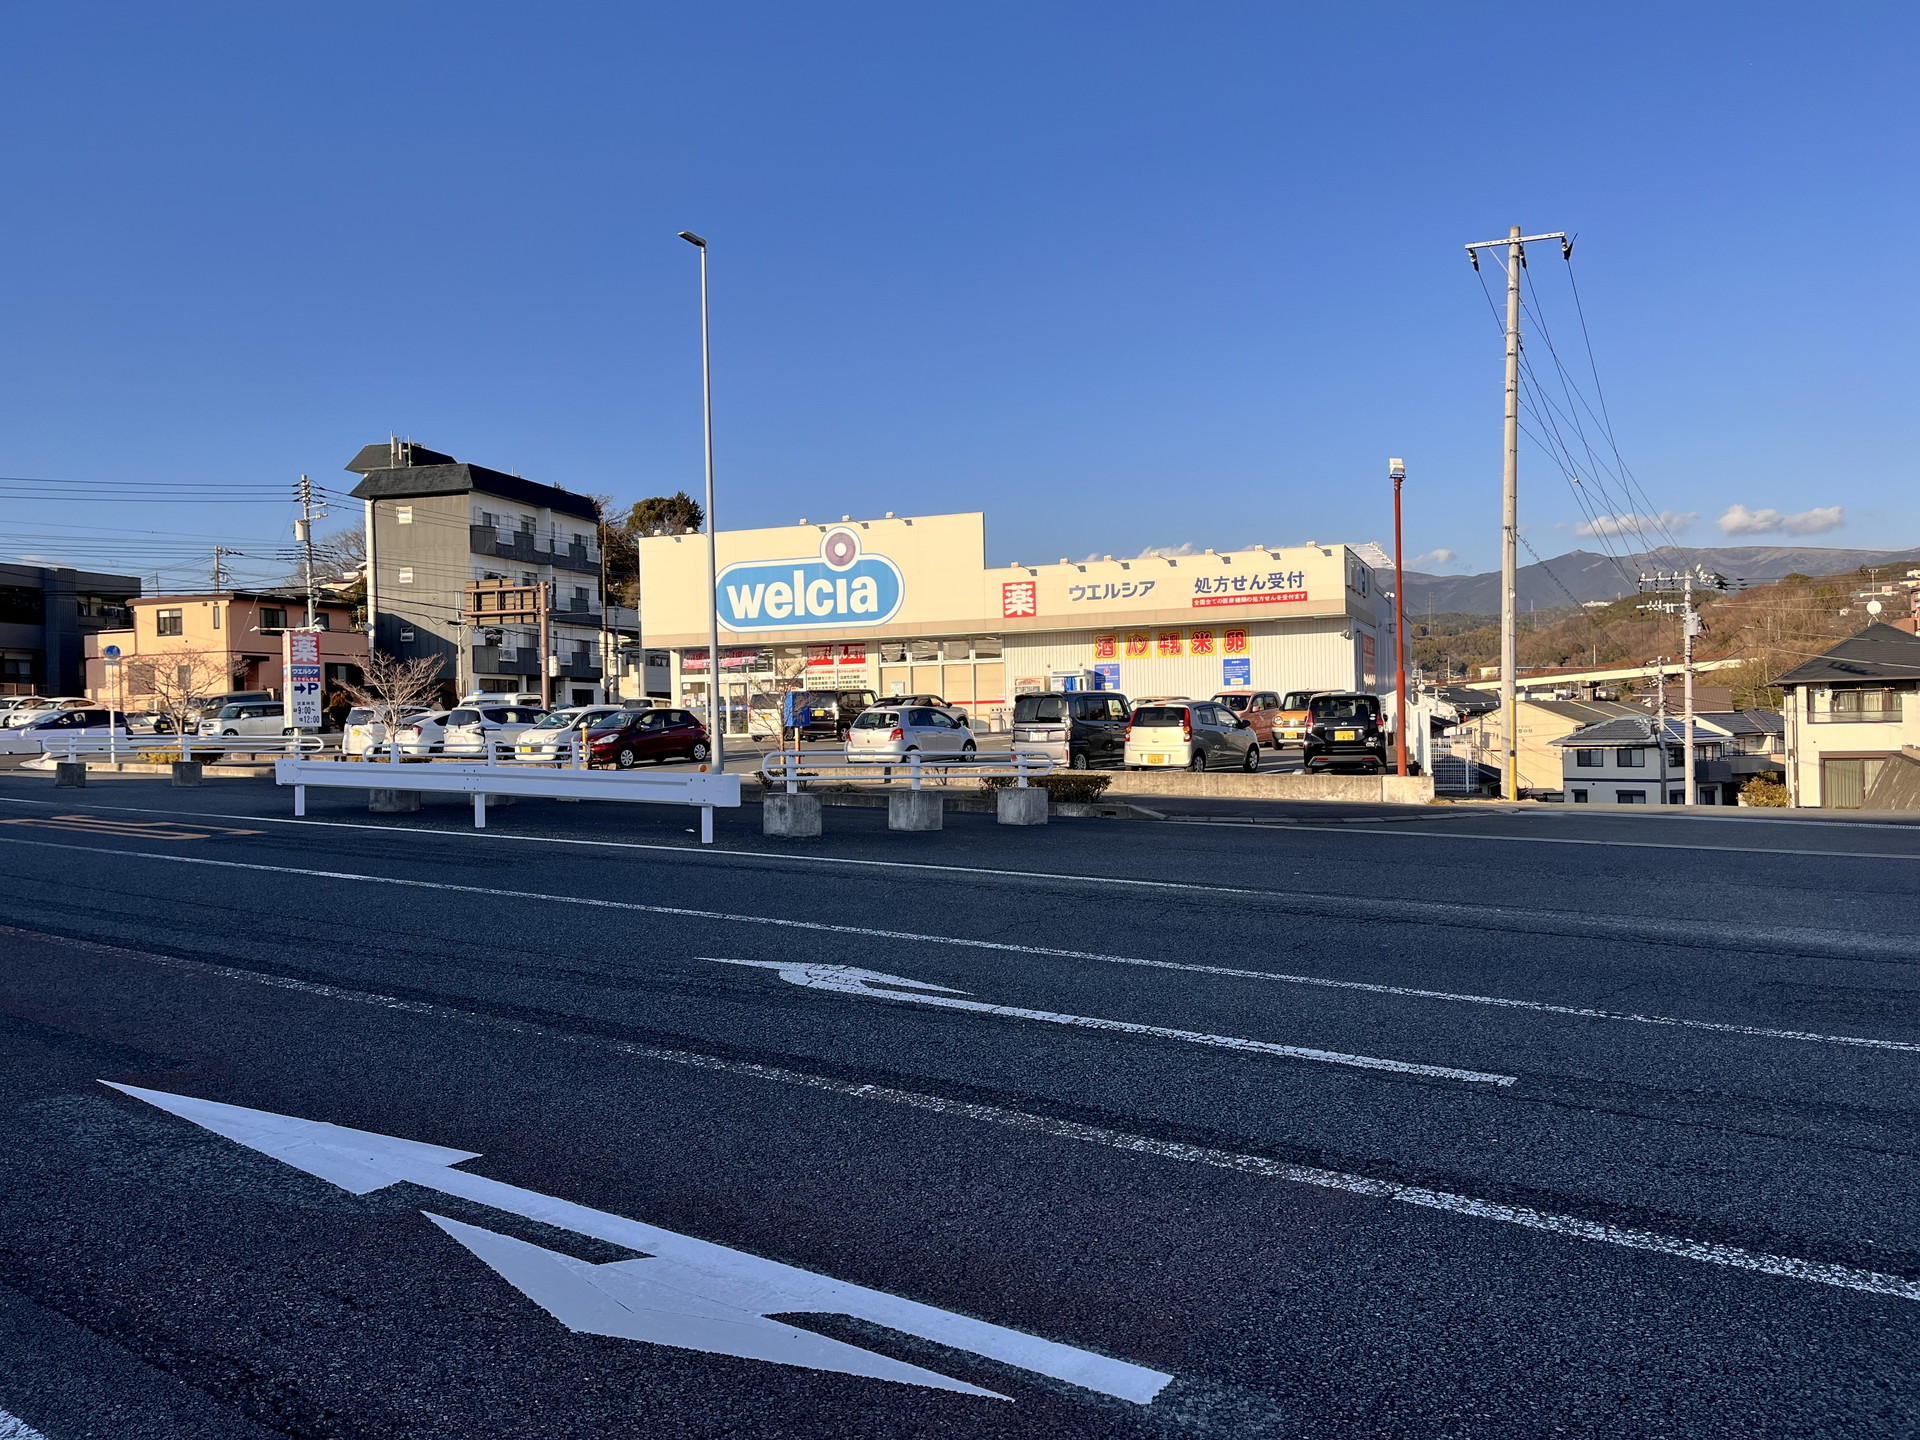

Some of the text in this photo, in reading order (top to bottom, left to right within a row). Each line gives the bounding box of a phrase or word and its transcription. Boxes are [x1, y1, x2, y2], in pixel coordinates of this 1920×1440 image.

[726, 569, 878, 619] welcia
[1069, 580, 1155, 602] ウエルシア
[1194, 571, 1305, 594] 処方せん受付
[1004, 583, 1035, 616] 薬
[292, 634, 318, 662] 薬
[1095, 629, 1247, 659] 酒 パン 牛乳 米 卵
[308, 683, 319, 694] P
